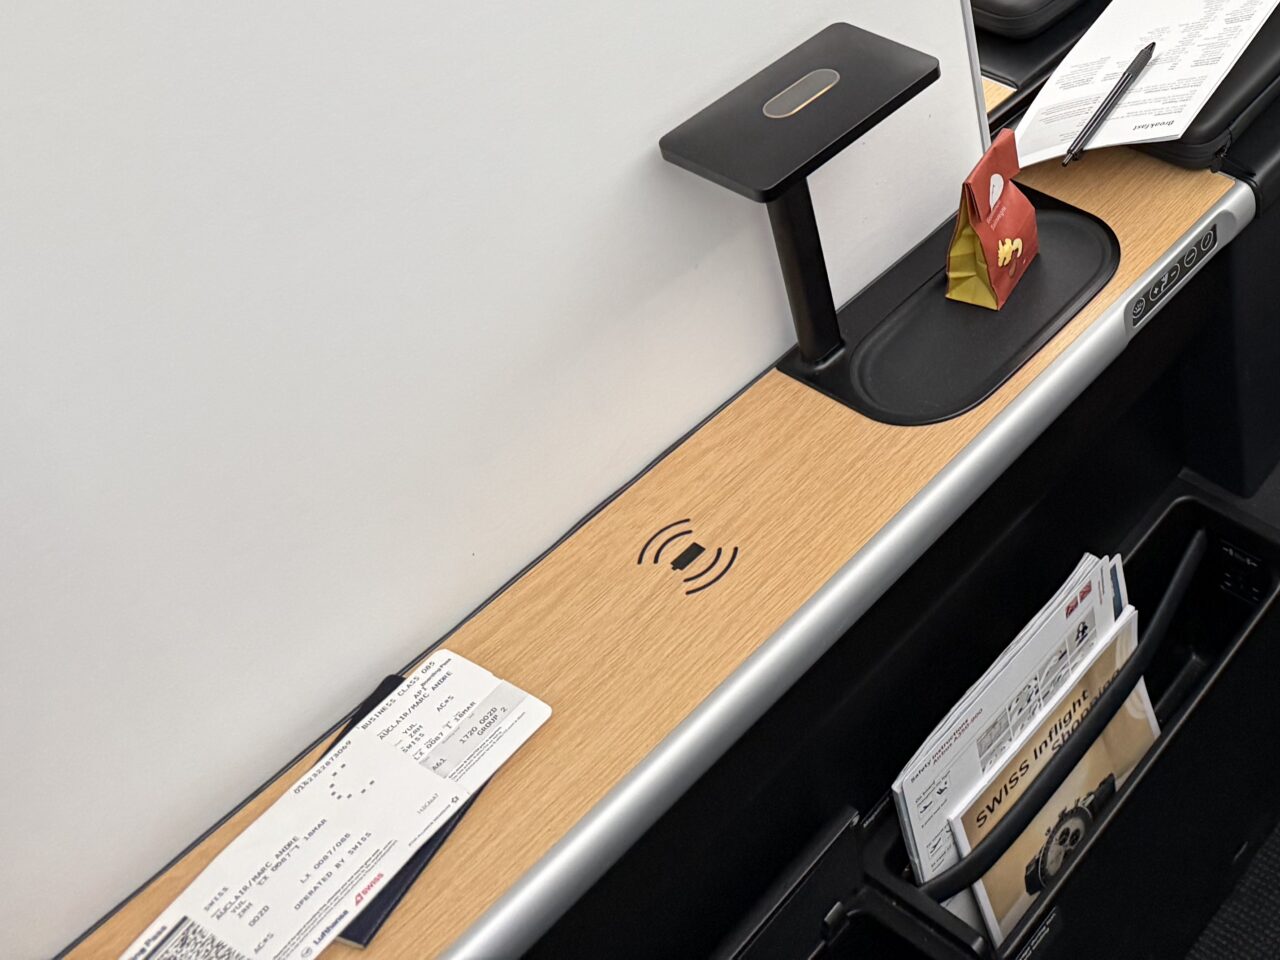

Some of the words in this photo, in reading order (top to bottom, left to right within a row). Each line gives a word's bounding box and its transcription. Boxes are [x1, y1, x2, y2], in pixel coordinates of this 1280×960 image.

[1132, 120, 1175, 131] Breakfast
[361, 699, 396, 730] BUSINESS
[397, 676, 420, 697] CLASS
[377, 693, 430, 740] AUCLAIR/MARC
[431, 672, 453, 691] ANDRE
[402, 723, 417, 734] YUL
[459, 726, 478, 744] 1720
[477, 714, 498, 736] GROUP
[401, 733, 425, 753] SWISS
[911, 759, 931, 783] Safety
[975, 760, 1031, 828] SWISS
[1033, 689, 1090, 761] Inflight
[213, 861, 273, 920] AUCLAIR/MARC
[275, 837, 299, 859] ANDRE
[294, 871, 333, 910] OPERATED
[334, 858, 345, 869] BY
[347, 832, 372, 855] SWISS
[313, 910, 349, 945] Lufthansa
